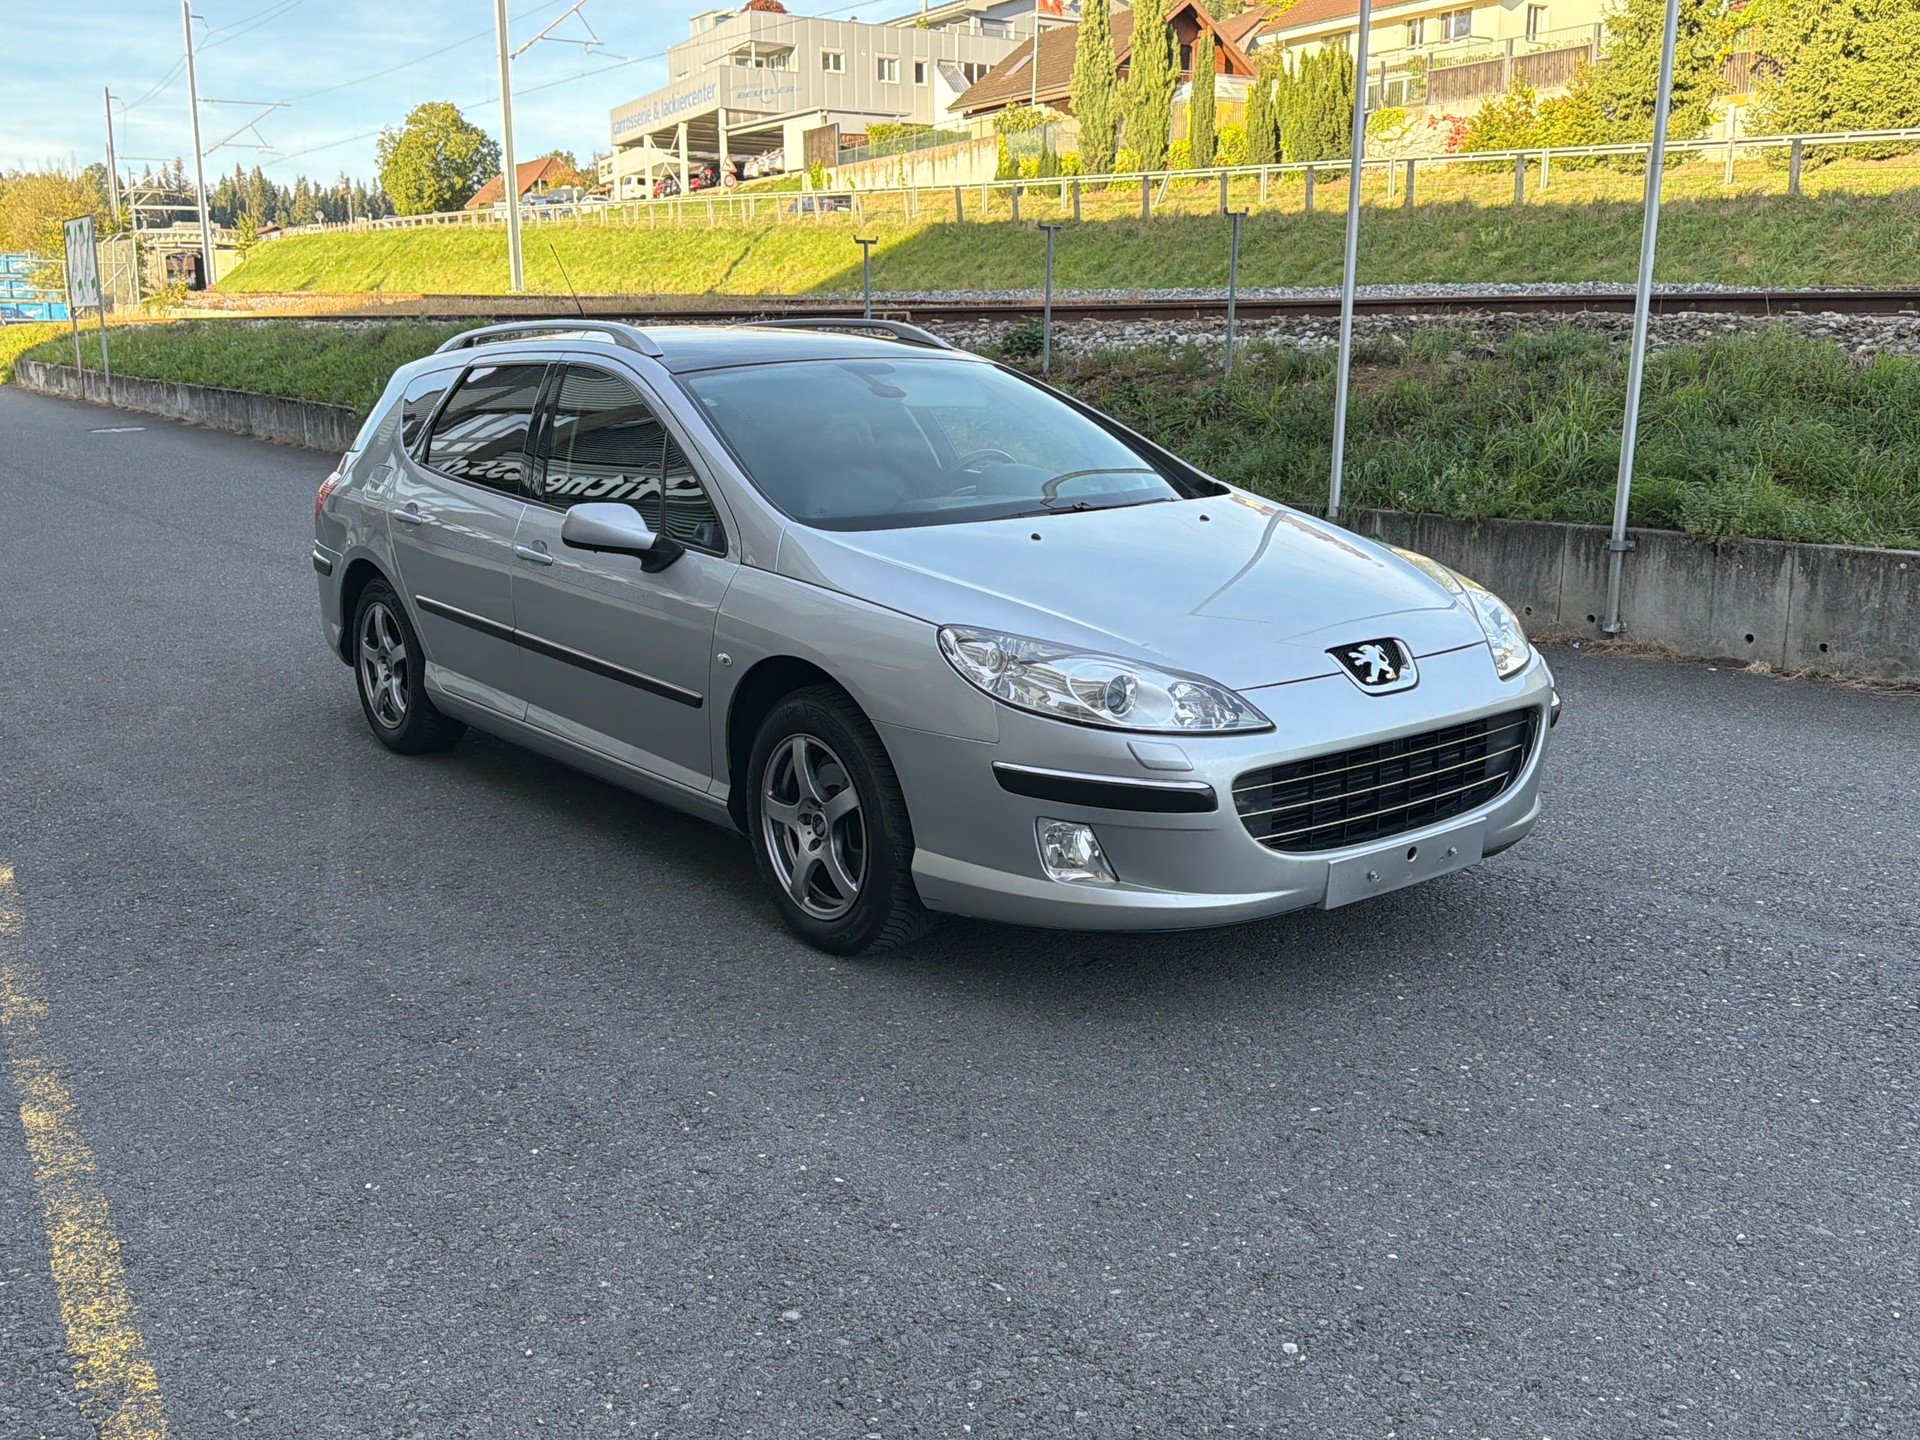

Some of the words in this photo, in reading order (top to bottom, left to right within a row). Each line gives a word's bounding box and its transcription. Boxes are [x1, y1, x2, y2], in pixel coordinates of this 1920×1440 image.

[737, 85, 796, 99] BEUTLER
[613, 104, 652, 134] carrosserie
[653, 101, 660, 120] &
[661, 83, 716, 117] lackiercenter
